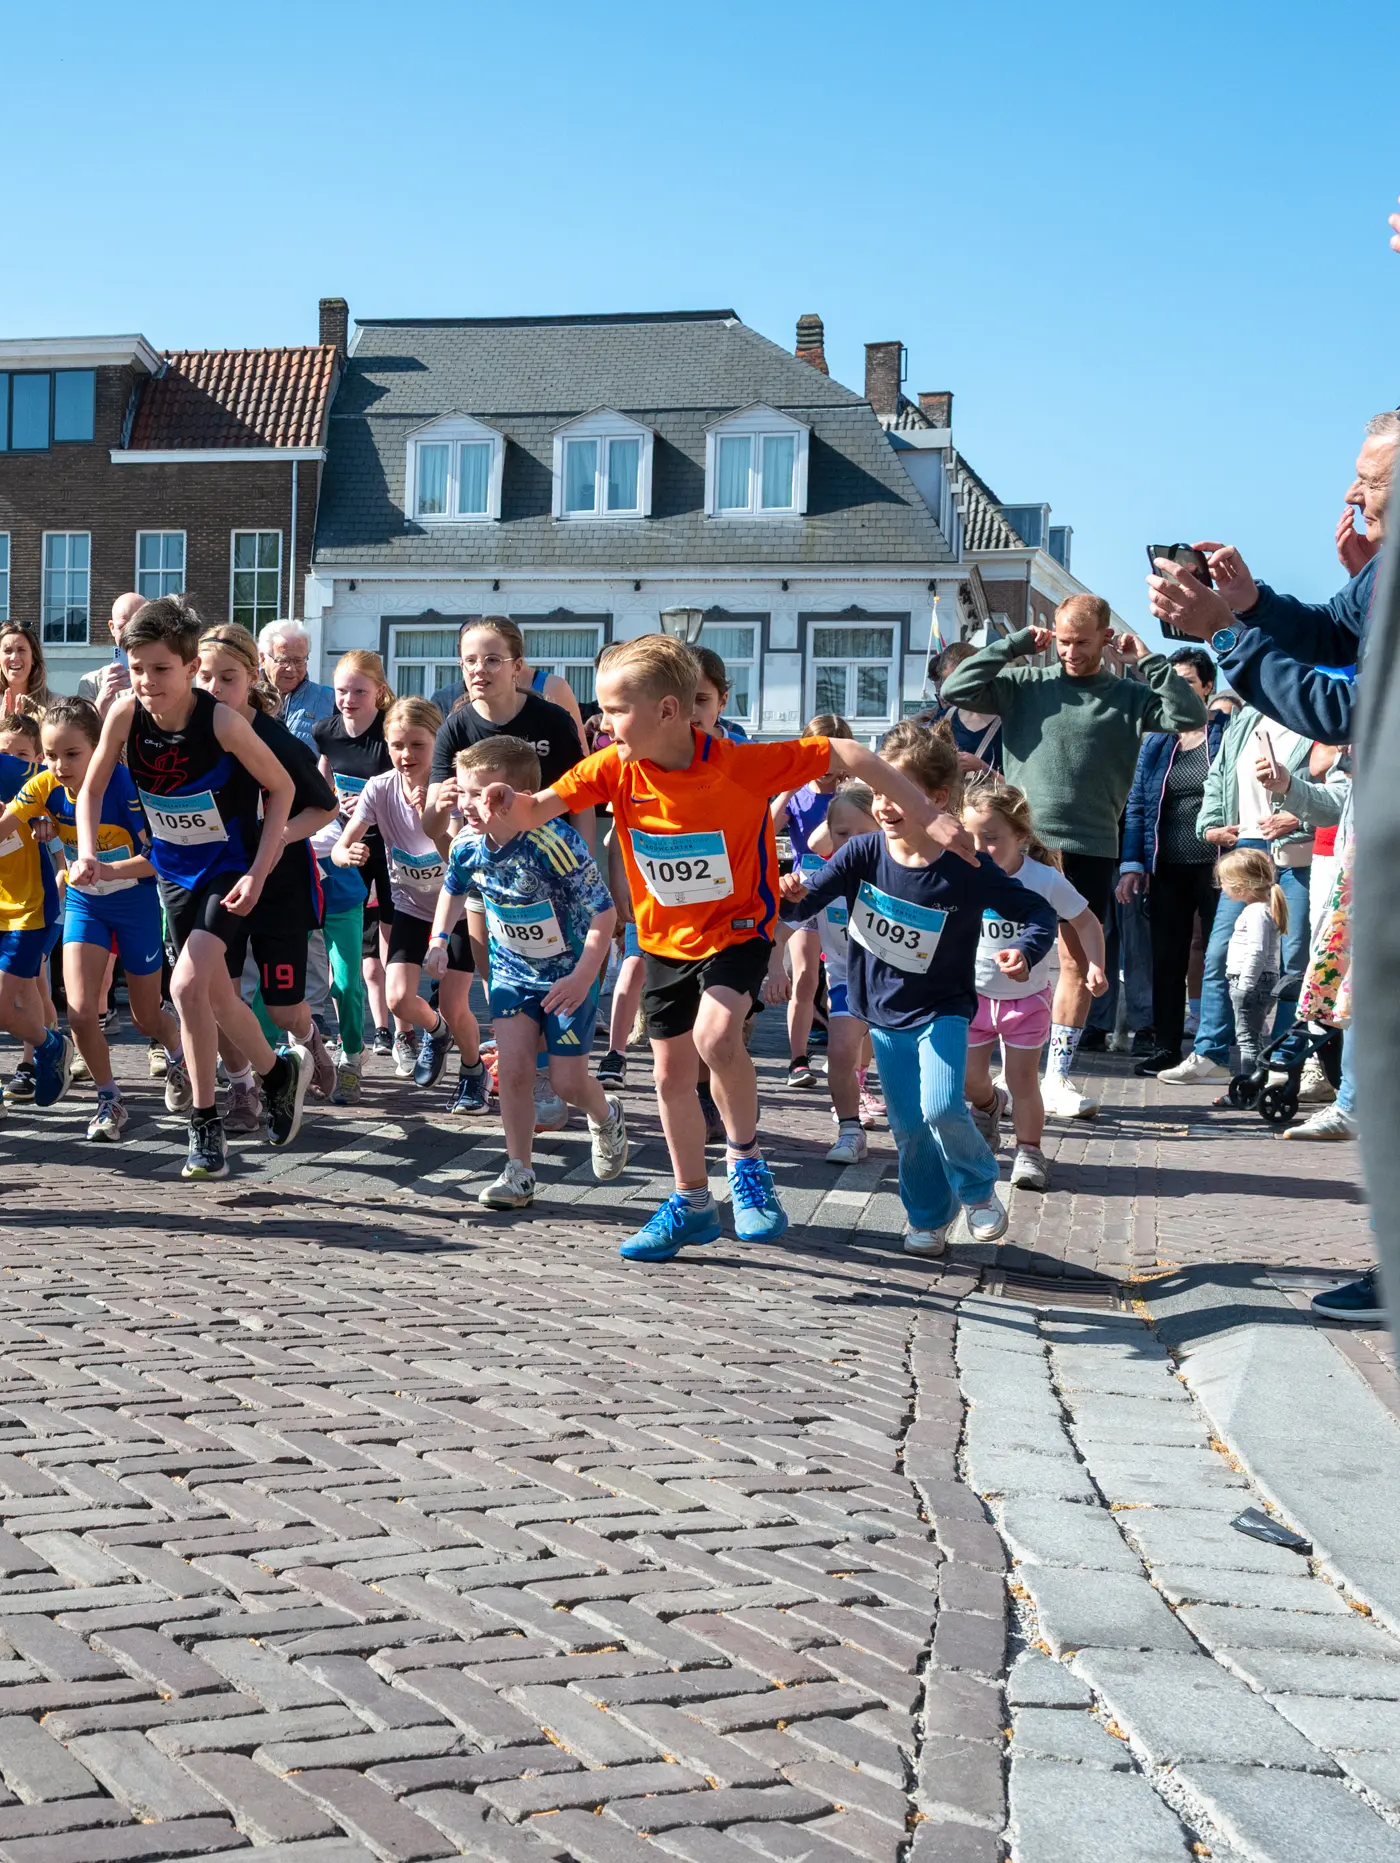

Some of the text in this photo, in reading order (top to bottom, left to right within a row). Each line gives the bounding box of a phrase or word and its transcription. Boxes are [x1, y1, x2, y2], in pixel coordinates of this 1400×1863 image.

[155, 812, 206, 829] 1056
[401, 865, 444, 880] 1052
[646, 859, 711, 882] 1092
[497, 919, 544, 940] 1089
[865, 912, 921, 949] 1093
[263, 963, 294, 989] 19
